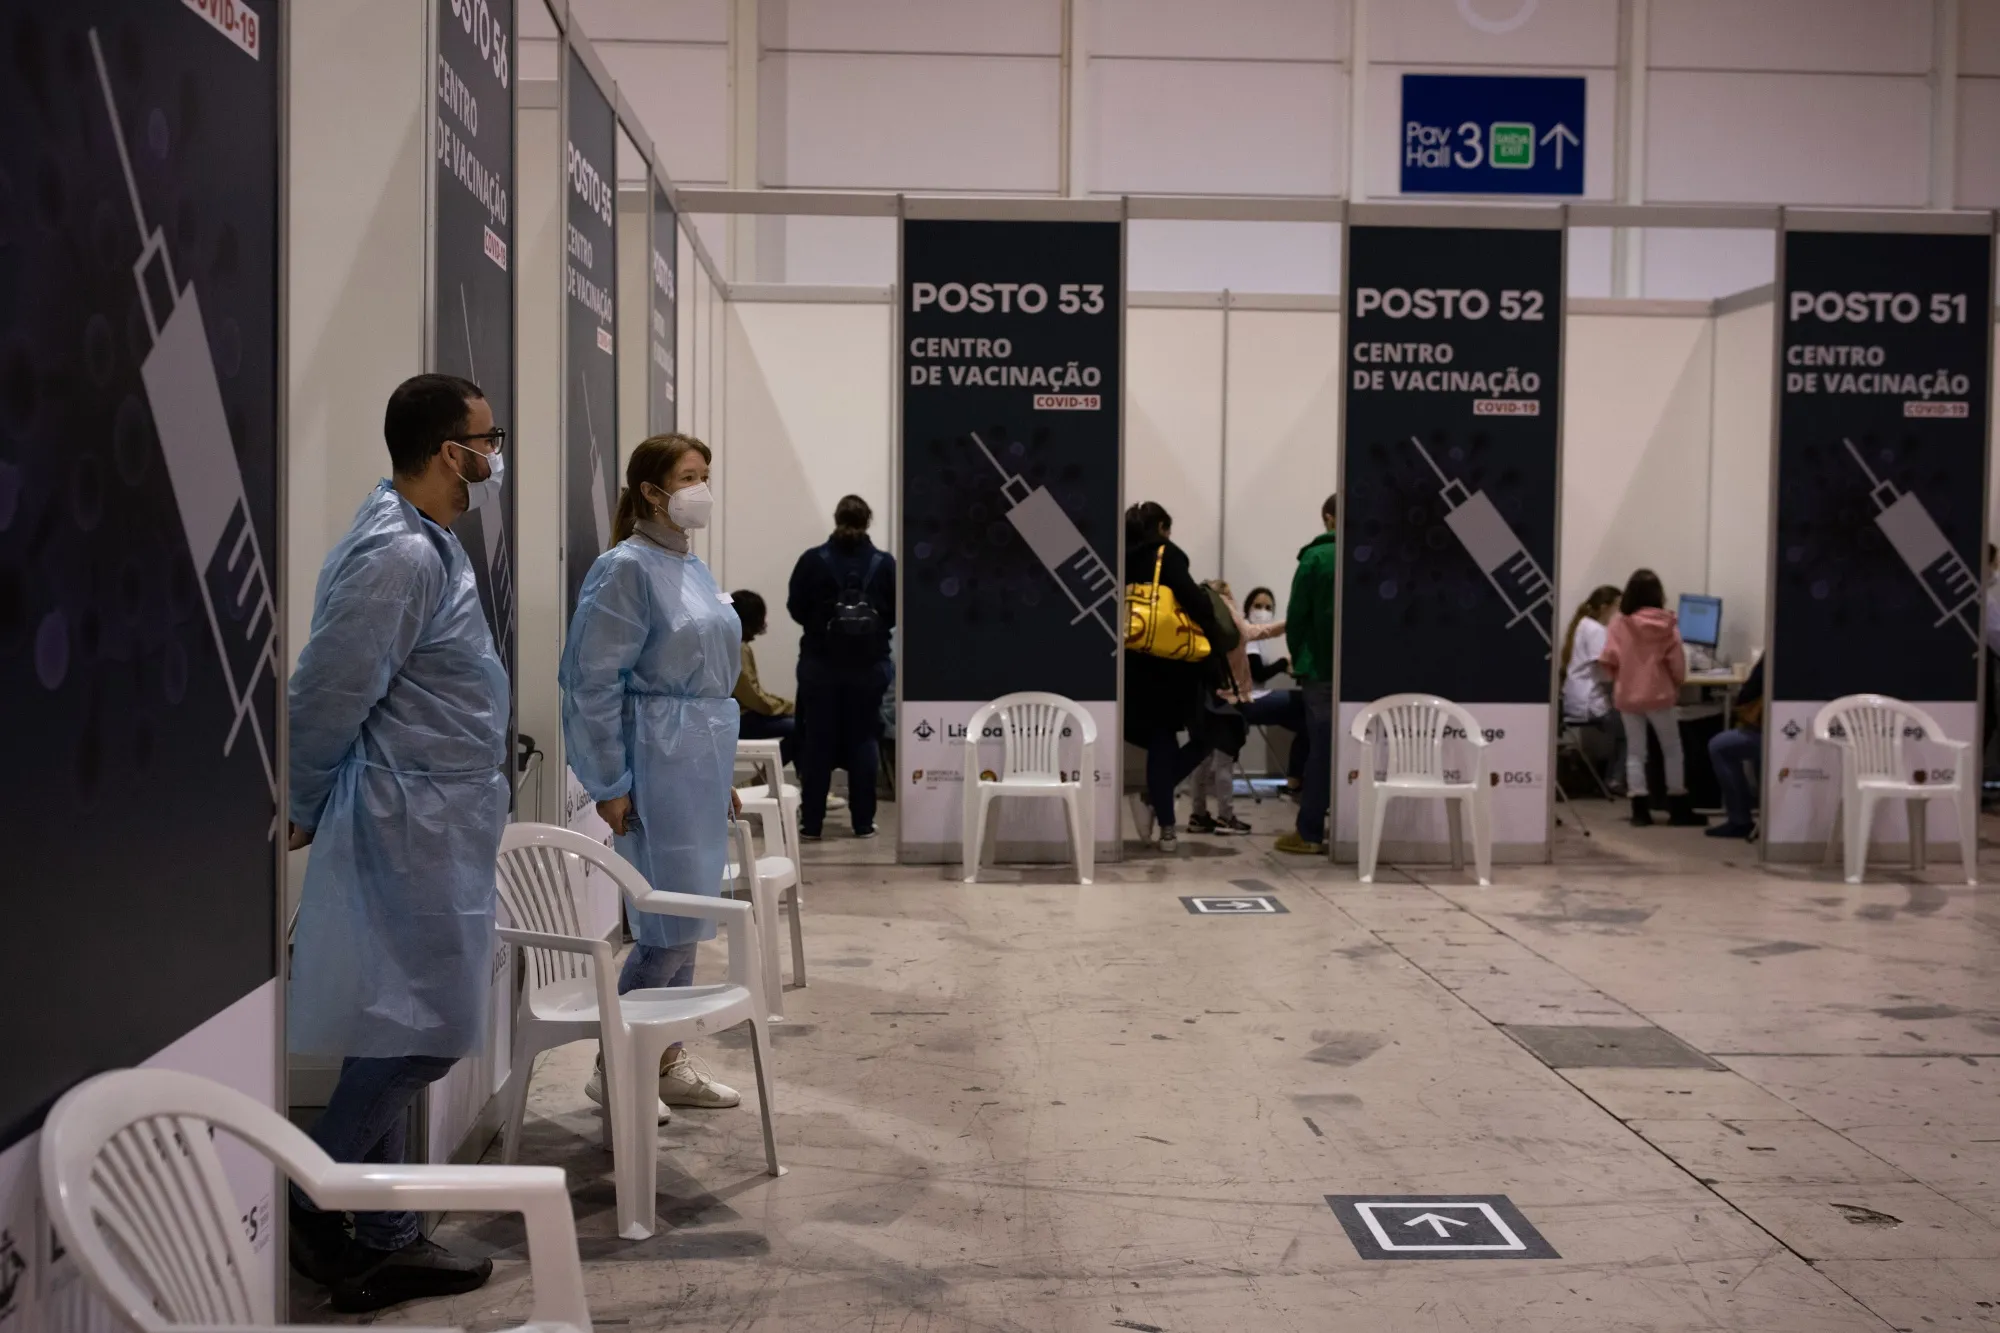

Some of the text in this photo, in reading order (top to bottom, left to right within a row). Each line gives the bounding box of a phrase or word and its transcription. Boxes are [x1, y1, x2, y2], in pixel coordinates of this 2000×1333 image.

[191, 0, 256, 48] VID-19
[452, 0, 508, 89] STO 56
[1407, 121, 1484, 169] Pav 3
[1407, 145, 1450, 168] Hall
[452, 132, 507, 226] VACINAÇÃO
[568, 140, 612, 227] POSTO 55
[912, 282, 1105, 314] POSTO 53
[1356, 287, 1544, 321] POSTO 52
[1790, 291, 1967, 324] POSTO 51
[910, 337, 1012, 358] CENTRO
[1353, 342, 1454, 363] CENTRO
[1787, 345, 1885, 367] CENTRO
[910, 361, 1101, 392] DE VACINAÇÃO
[1353, 367, 1541, 397] DE VACINAÇÃO
[1787, 369, 1970, 399] DE VACINAÇÃO
[1036, 397, 1098, 408] COVID-19
[1476, 402, 1537, 413] COVID-19
[948, 724, 1003, 737] Lisoa
[1442, 725, 1505, 742] Proge
[1071, 769, 1101, 782] DS
[1503, 771, 1533, 784] DGS
